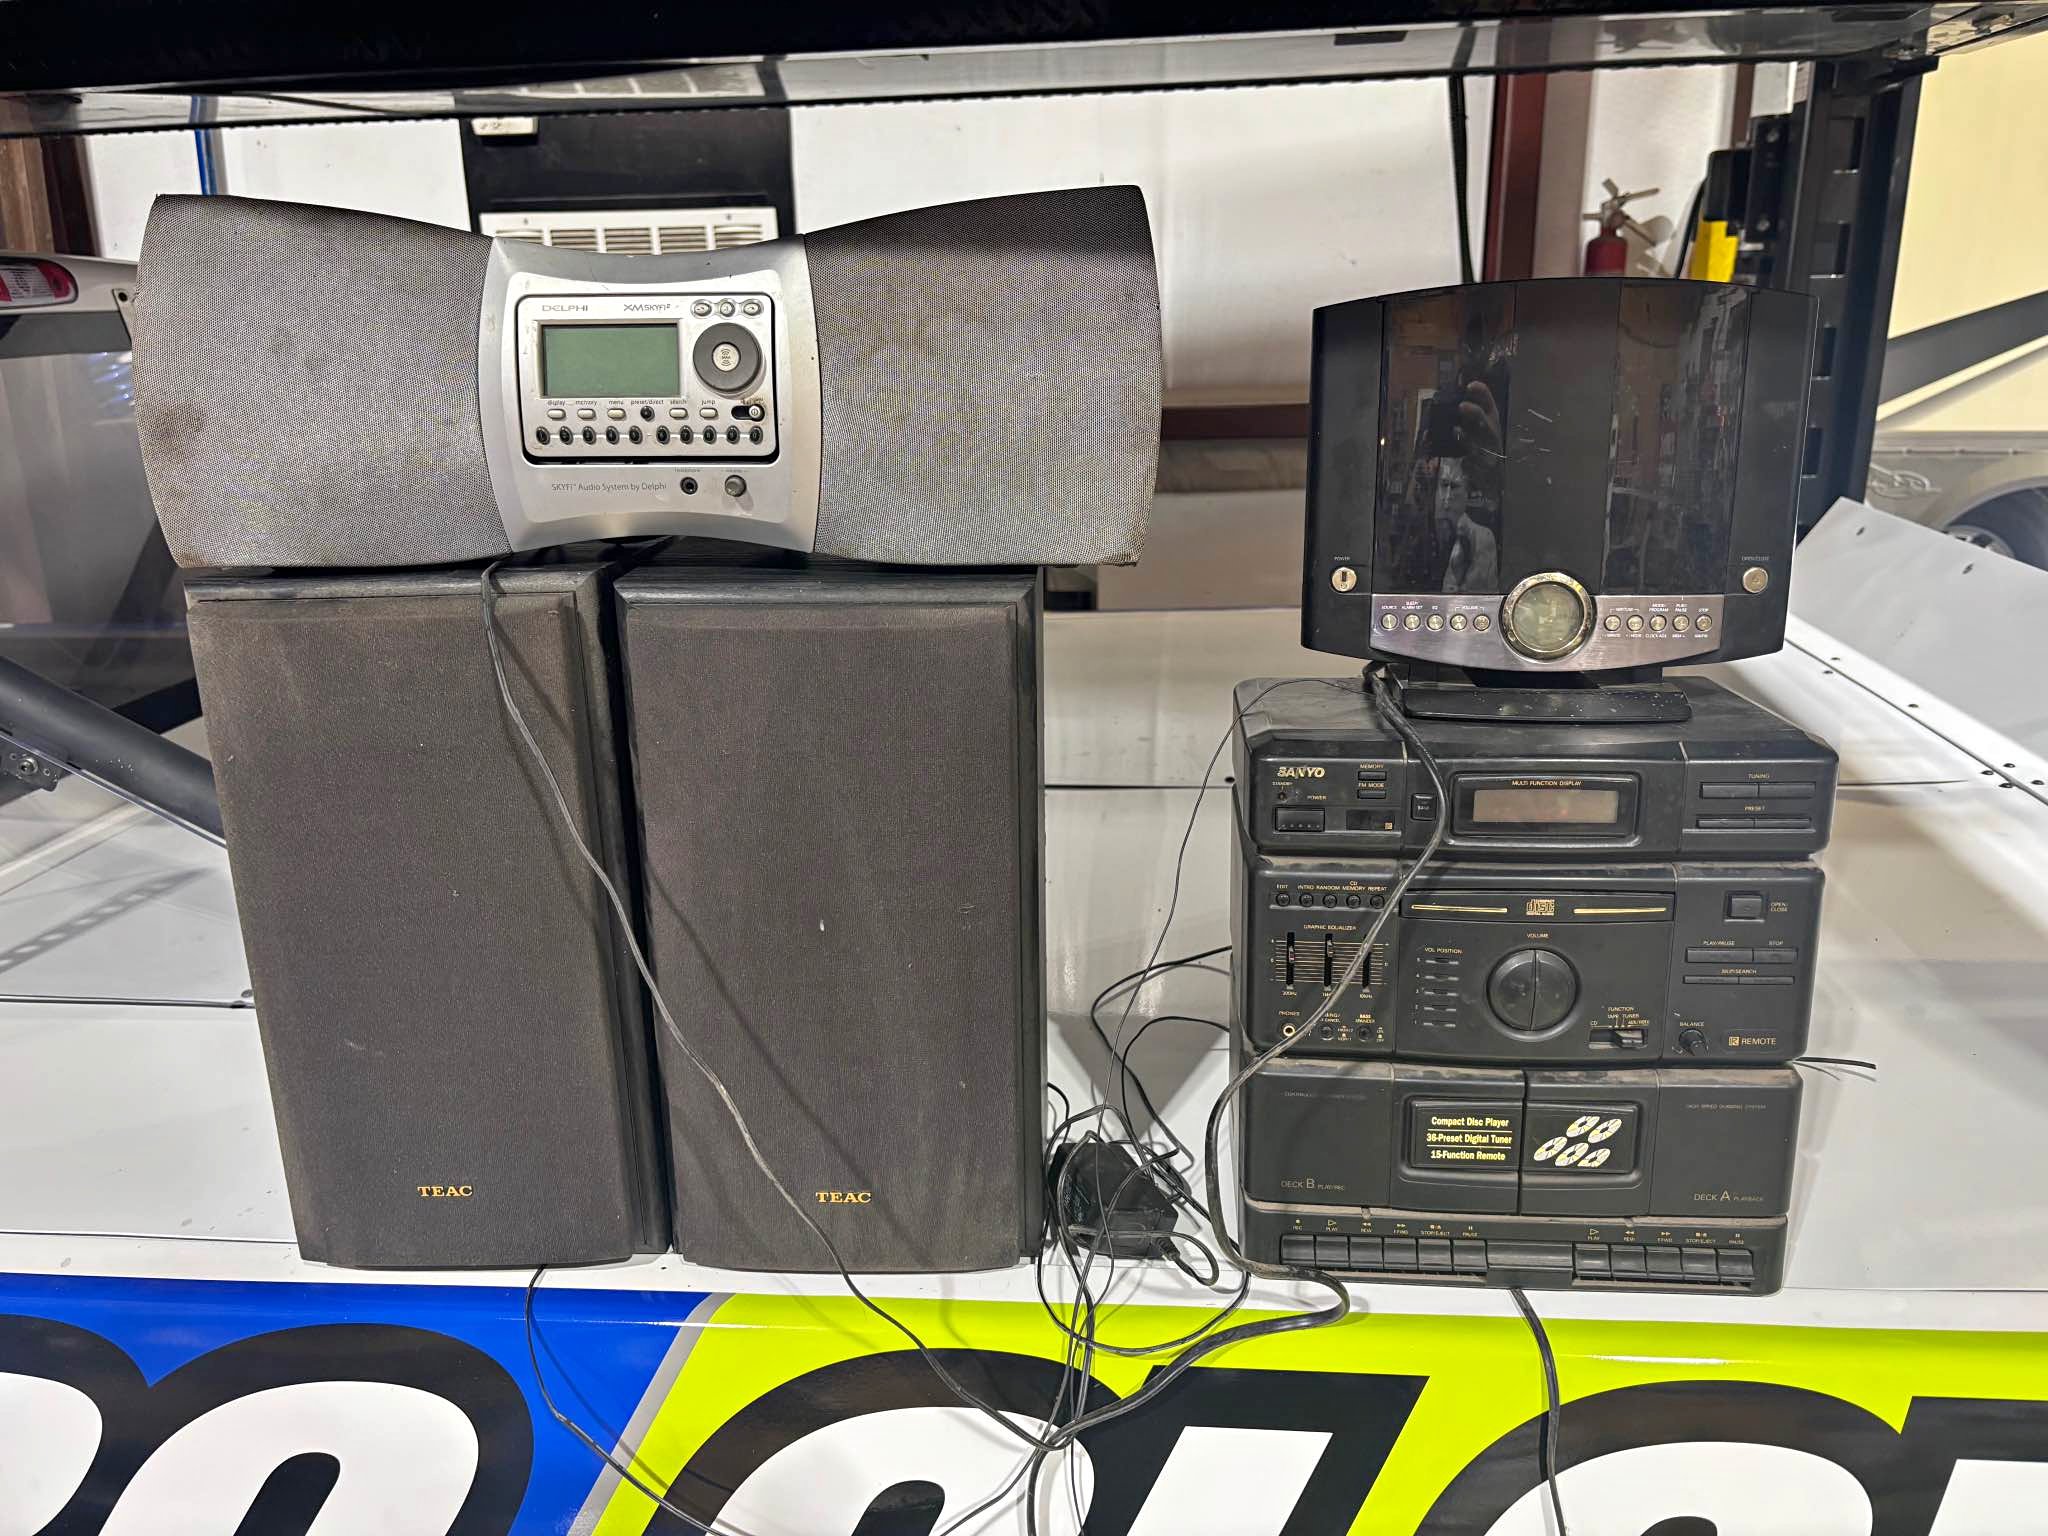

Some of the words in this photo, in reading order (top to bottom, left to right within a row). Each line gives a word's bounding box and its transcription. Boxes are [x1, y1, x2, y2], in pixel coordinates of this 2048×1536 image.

[541, 304, 588, 312] DELPHI
[578, 482, 601, 491] Audio
[602, 482, 630, 492] System
[630, 481, 640, 493] by
[641, 481, 668, 492] Delphi
[1277, 766, 1326, 778] SANYO
[1741, 1037, 1777, 1046] REMOTE
[1431, 1116, 1465, 1127] Compact
[1466, 1117, 1484, 1126] Disc
[1485, 1117, 1510, 1129] Player
[1426, 1133, 1464, 1143] 36-Preset
[1464, 1134, 1489, 1145] Digital
[1490, 1134, 1512, 1144] Tuner
[1430, 1149, 1475, 1160] 15-Function
[1476, 1150, 1506, 1161] Remote
[1280, 1180, 1304, 1188] DECK
[1306, 1178, 1315, 1189] B
[417, 1185, 473, 1197] TEAC
[1693, 1192, 1718, 1201] DECK
[1719, 1189, 1731, 1201] A
[815, 1191, 872, 1204] TEAC
